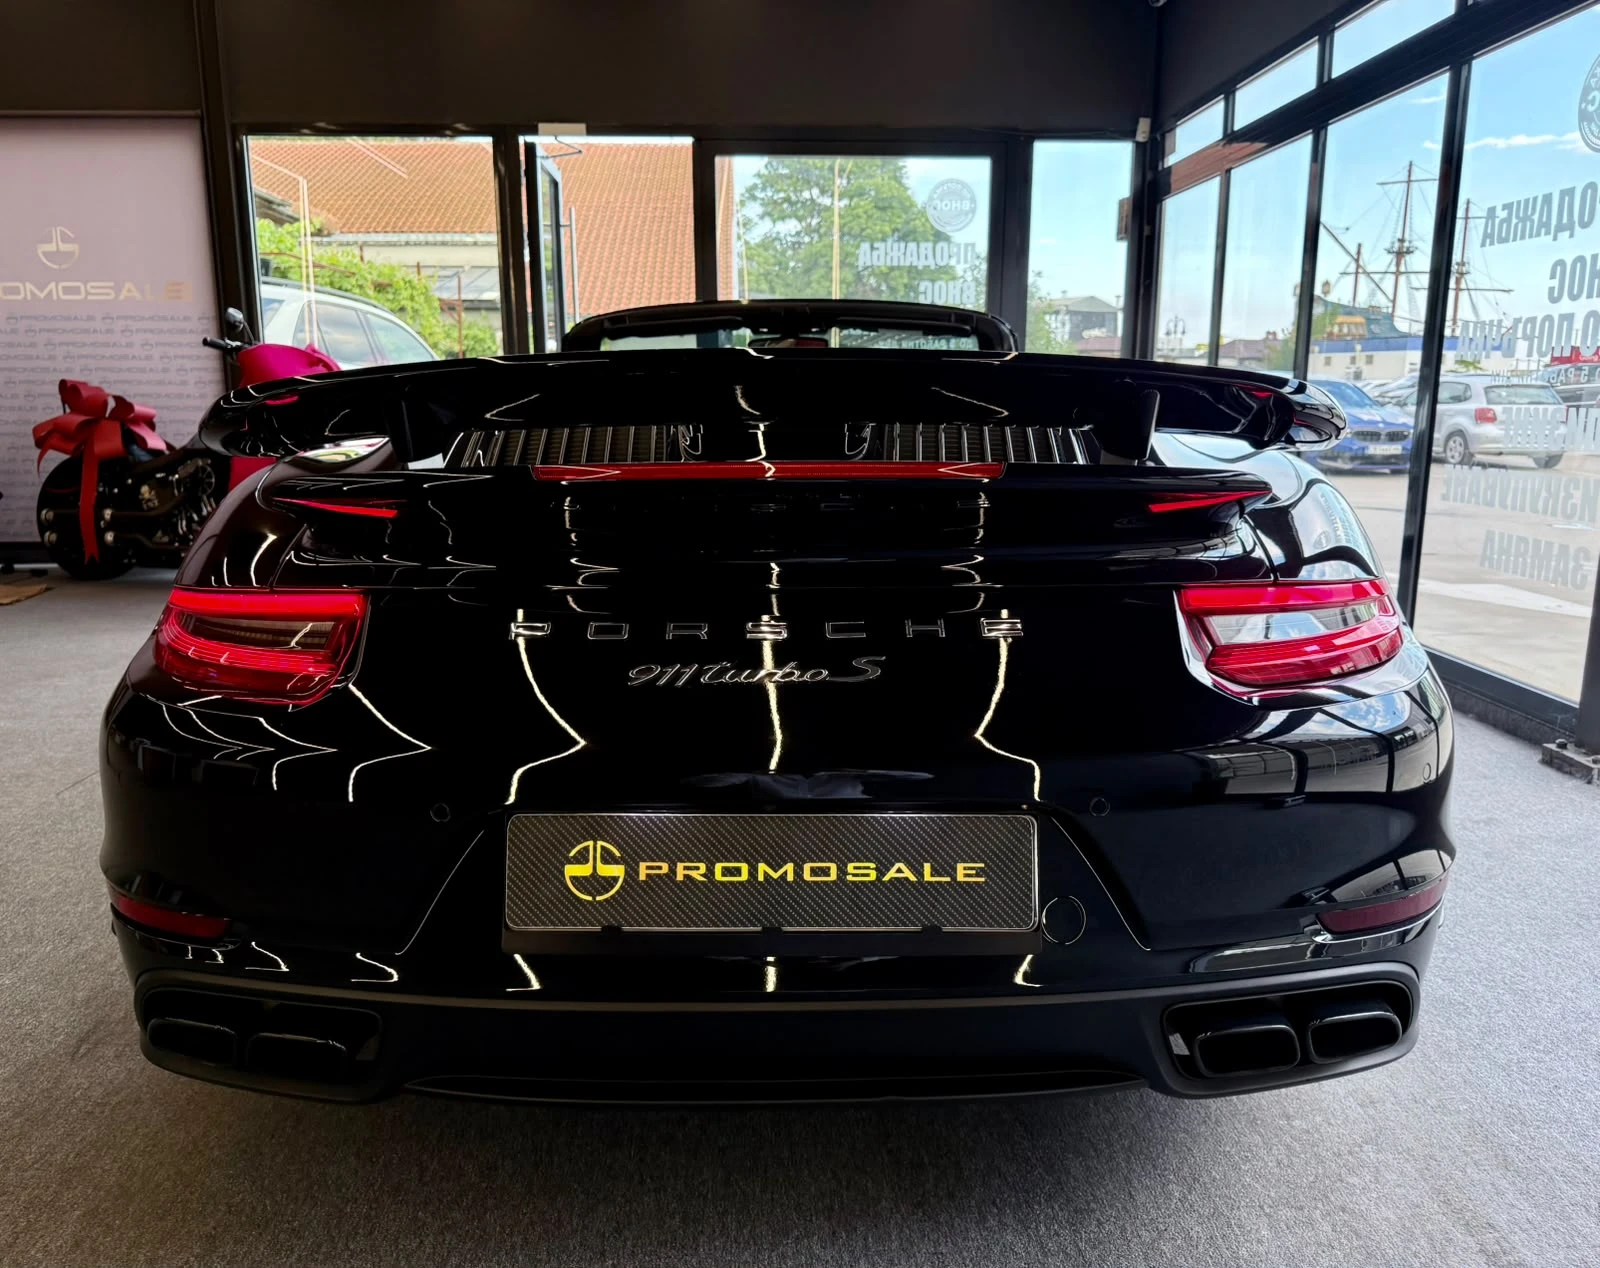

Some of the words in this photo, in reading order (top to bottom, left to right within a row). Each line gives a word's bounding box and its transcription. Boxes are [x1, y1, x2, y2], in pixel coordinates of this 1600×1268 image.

[508, 618, 1024, 641] PORSCHE
[628, 663, 699, 687] 911
[832, 656, 886, 682] S
[638, 862, 986, 882] PROMOSALE
